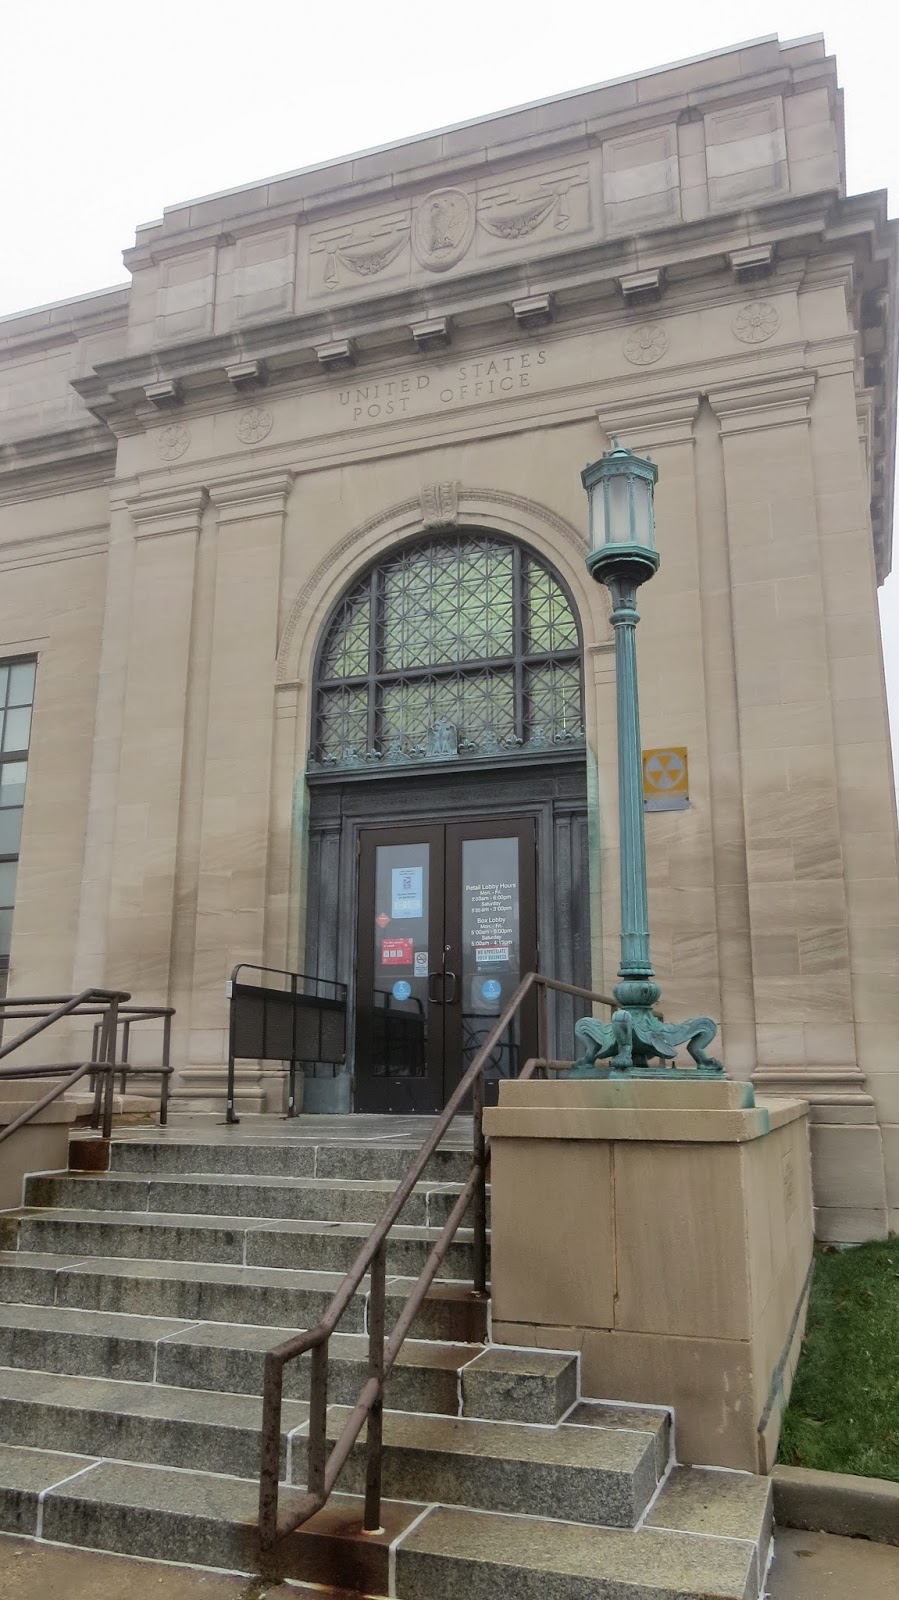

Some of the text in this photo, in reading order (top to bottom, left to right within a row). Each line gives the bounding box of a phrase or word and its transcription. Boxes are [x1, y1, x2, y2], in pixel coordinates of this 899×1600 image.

[339, 351, 547, 405] UNITED STATES
[353, 373, 530, 421] POST OFFICE
